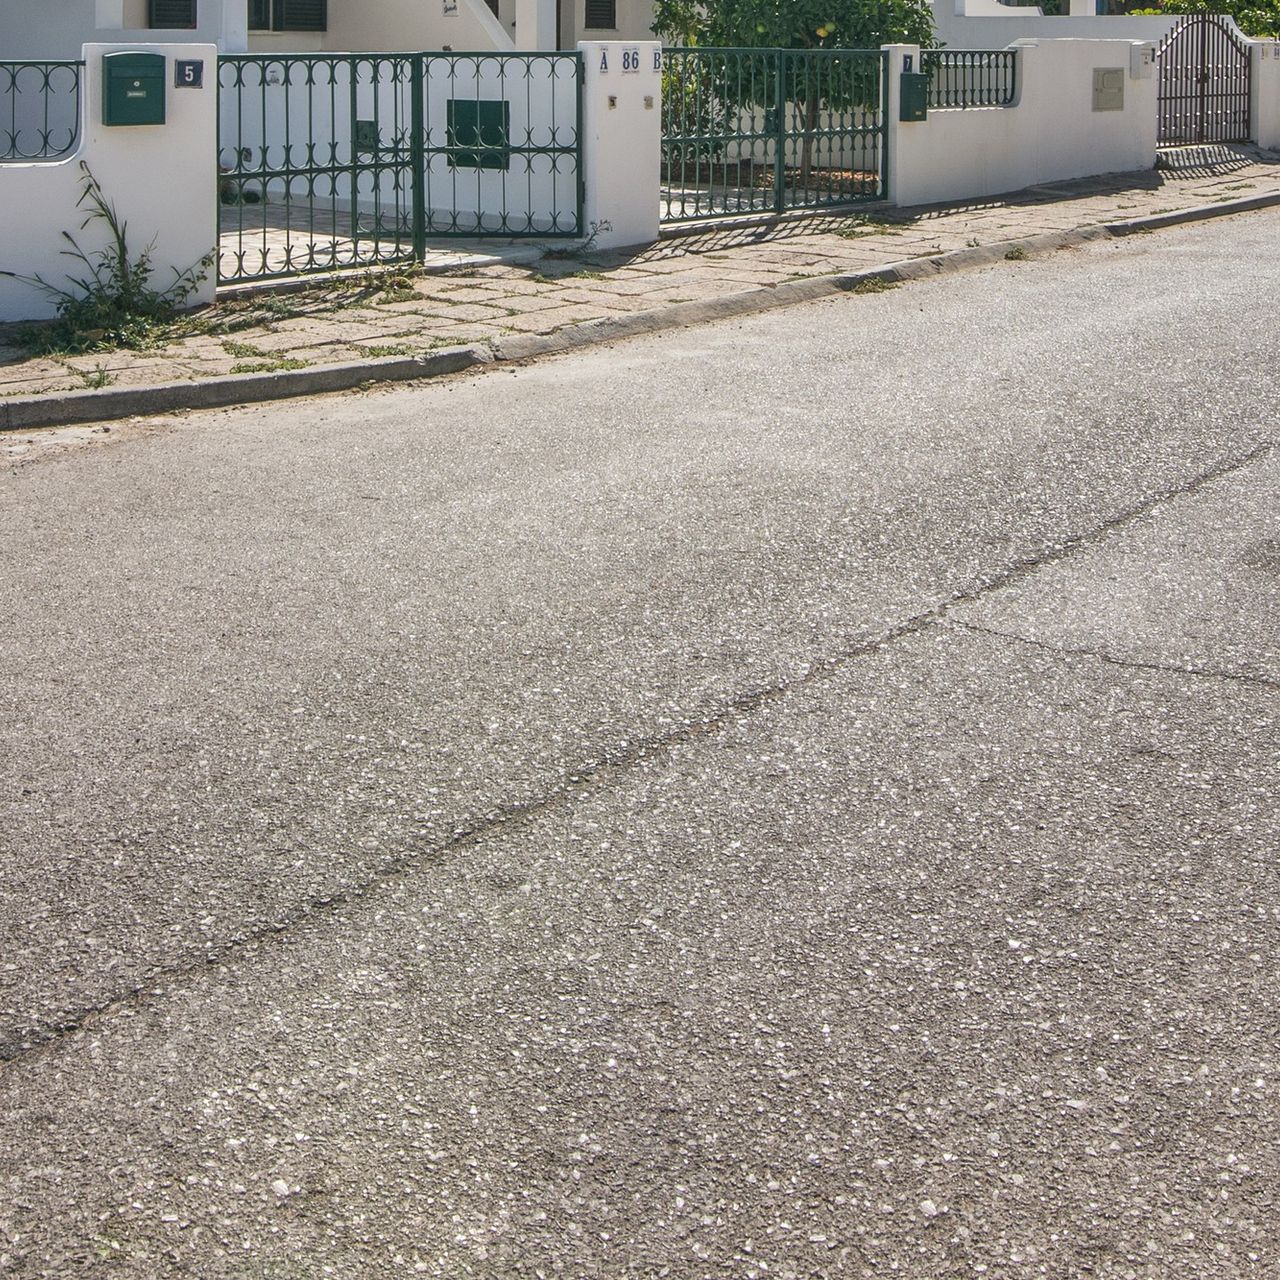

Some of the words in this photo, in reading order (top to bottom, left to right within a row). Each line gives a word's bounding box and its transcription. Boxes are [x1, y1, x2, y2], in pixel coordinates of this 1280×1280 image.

[600, 51, 608, 70] A
[622, 51, 639, 70] 86
[653, 52, 661, 70] B
[185, 66, 194, 82] 5
